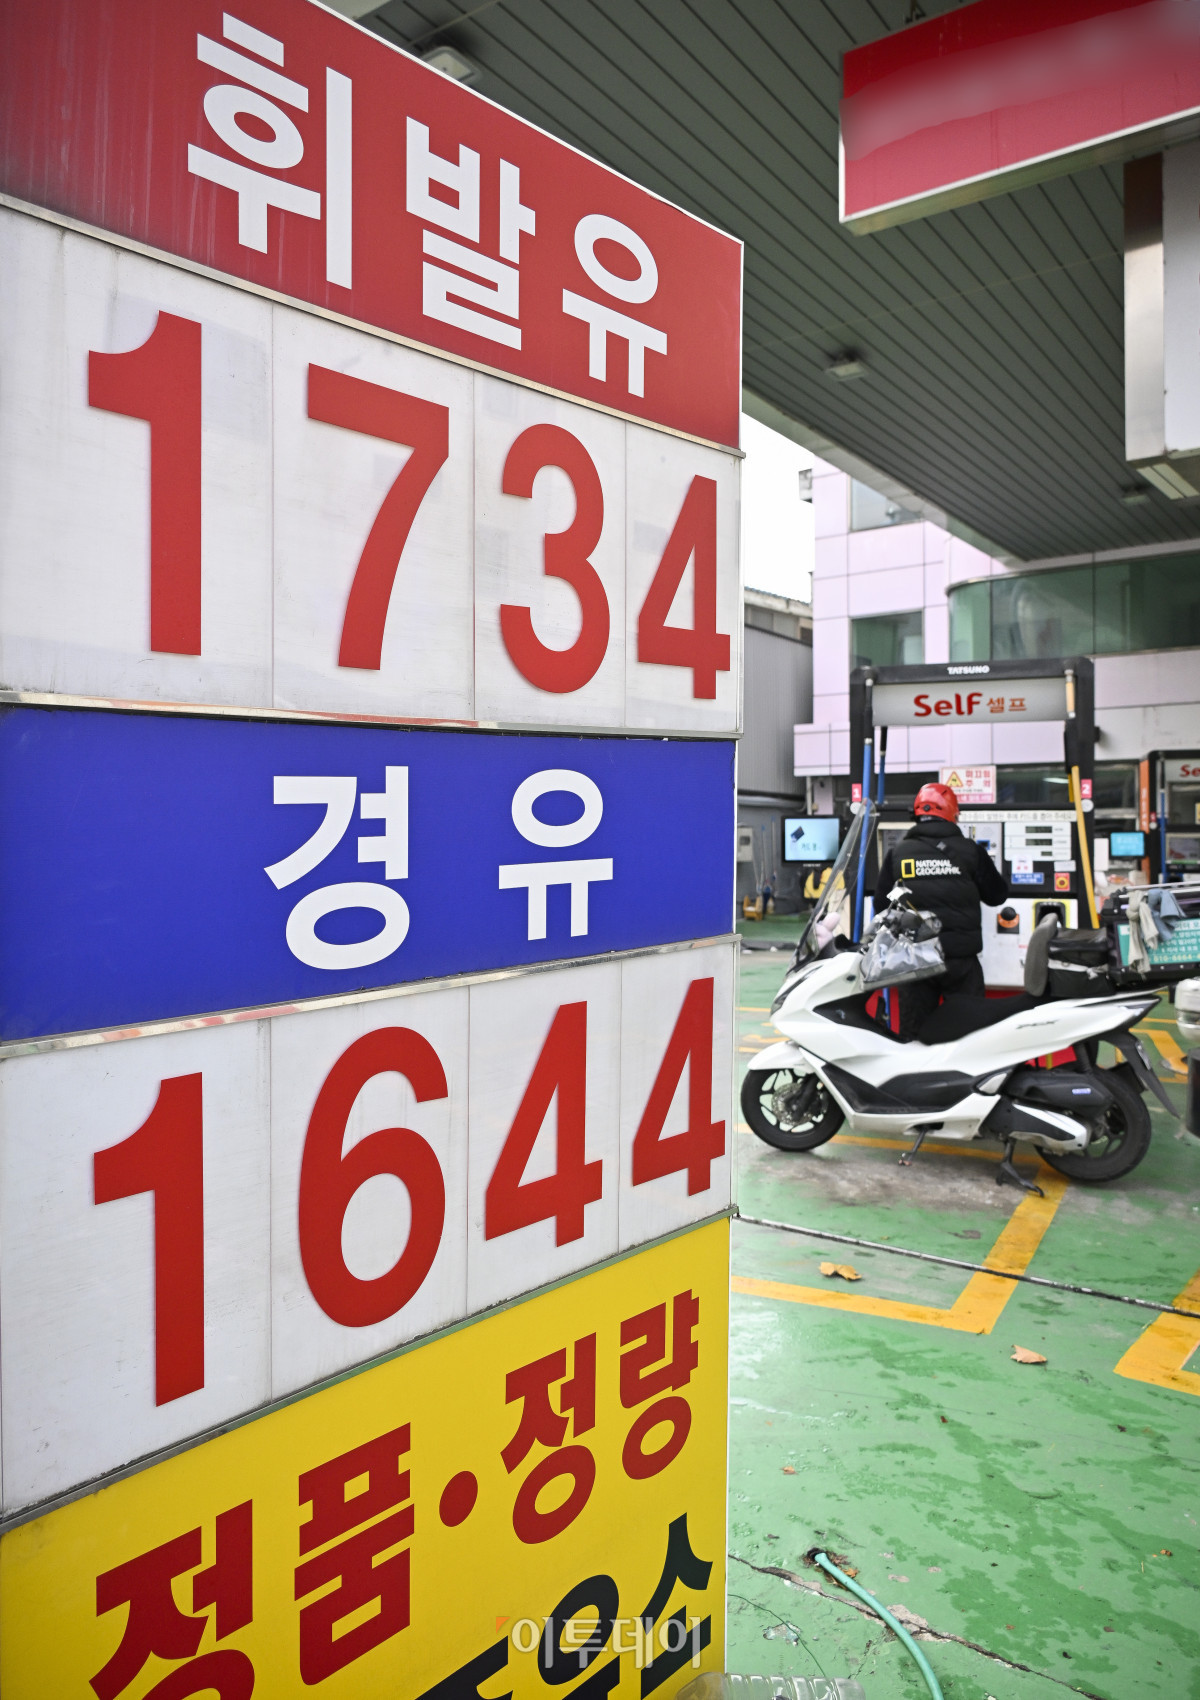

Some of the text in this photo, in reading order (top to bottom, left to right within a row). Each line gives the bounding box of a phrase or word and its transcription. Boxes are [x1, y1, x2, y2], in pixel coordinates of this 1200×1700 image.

[188, 12, 668, 398] 휘발유
[88, 310, 731, 700] 1734
[946, 665, 990, 675] TATSUNO
[913, 692, 984, 718] Self
[852, 788, 860, 798] 1
[1081, 783, 1091, 795] 2
[264, 765, 614, 970] 경유
[915, 859, 952, 868] NATIONAL
[94, 977, 726, 1407] 1644
